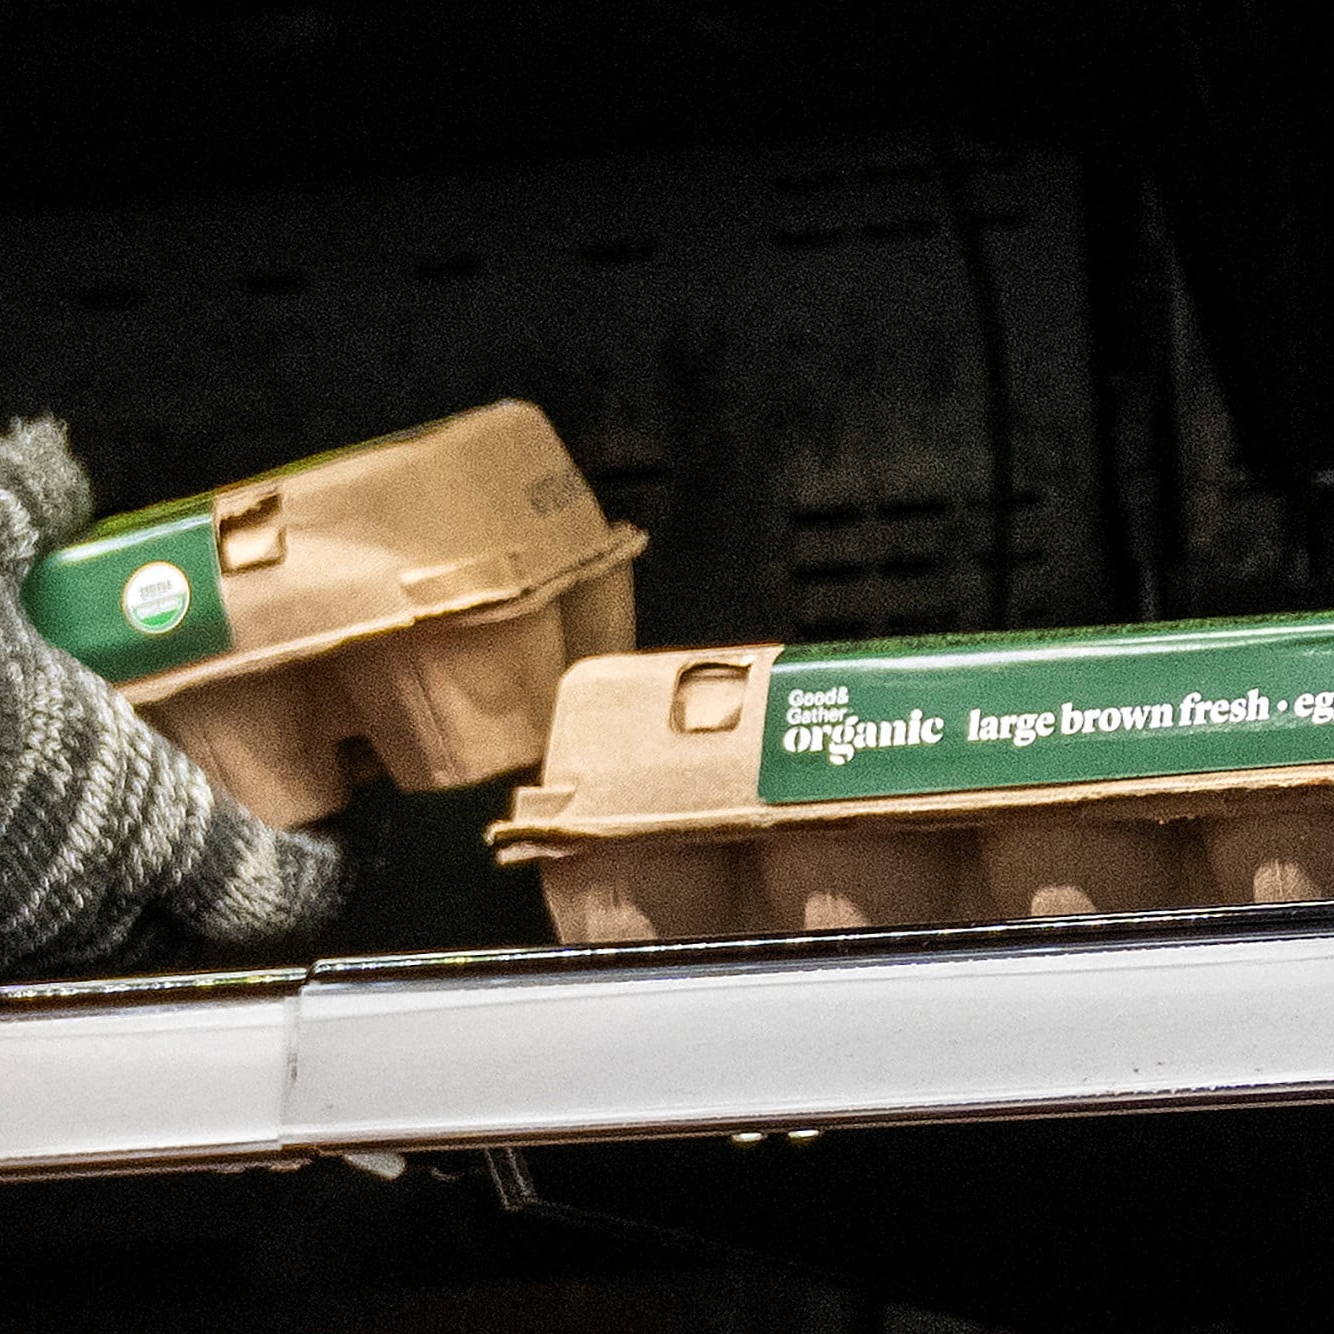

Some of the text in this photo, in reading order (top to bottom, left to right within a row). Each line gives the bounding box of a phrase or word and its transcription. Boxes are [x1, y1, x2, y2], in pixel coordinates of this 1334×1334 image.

[788, 685, 849, 707] Good&
[783, 708, 944, 765] organic
[967, 708, 1055, 747] large
[1061, 702, 1173, 737] brown
[1178, 688, 1270, 727] fresh
[787, 707, 846, 725] Gather
